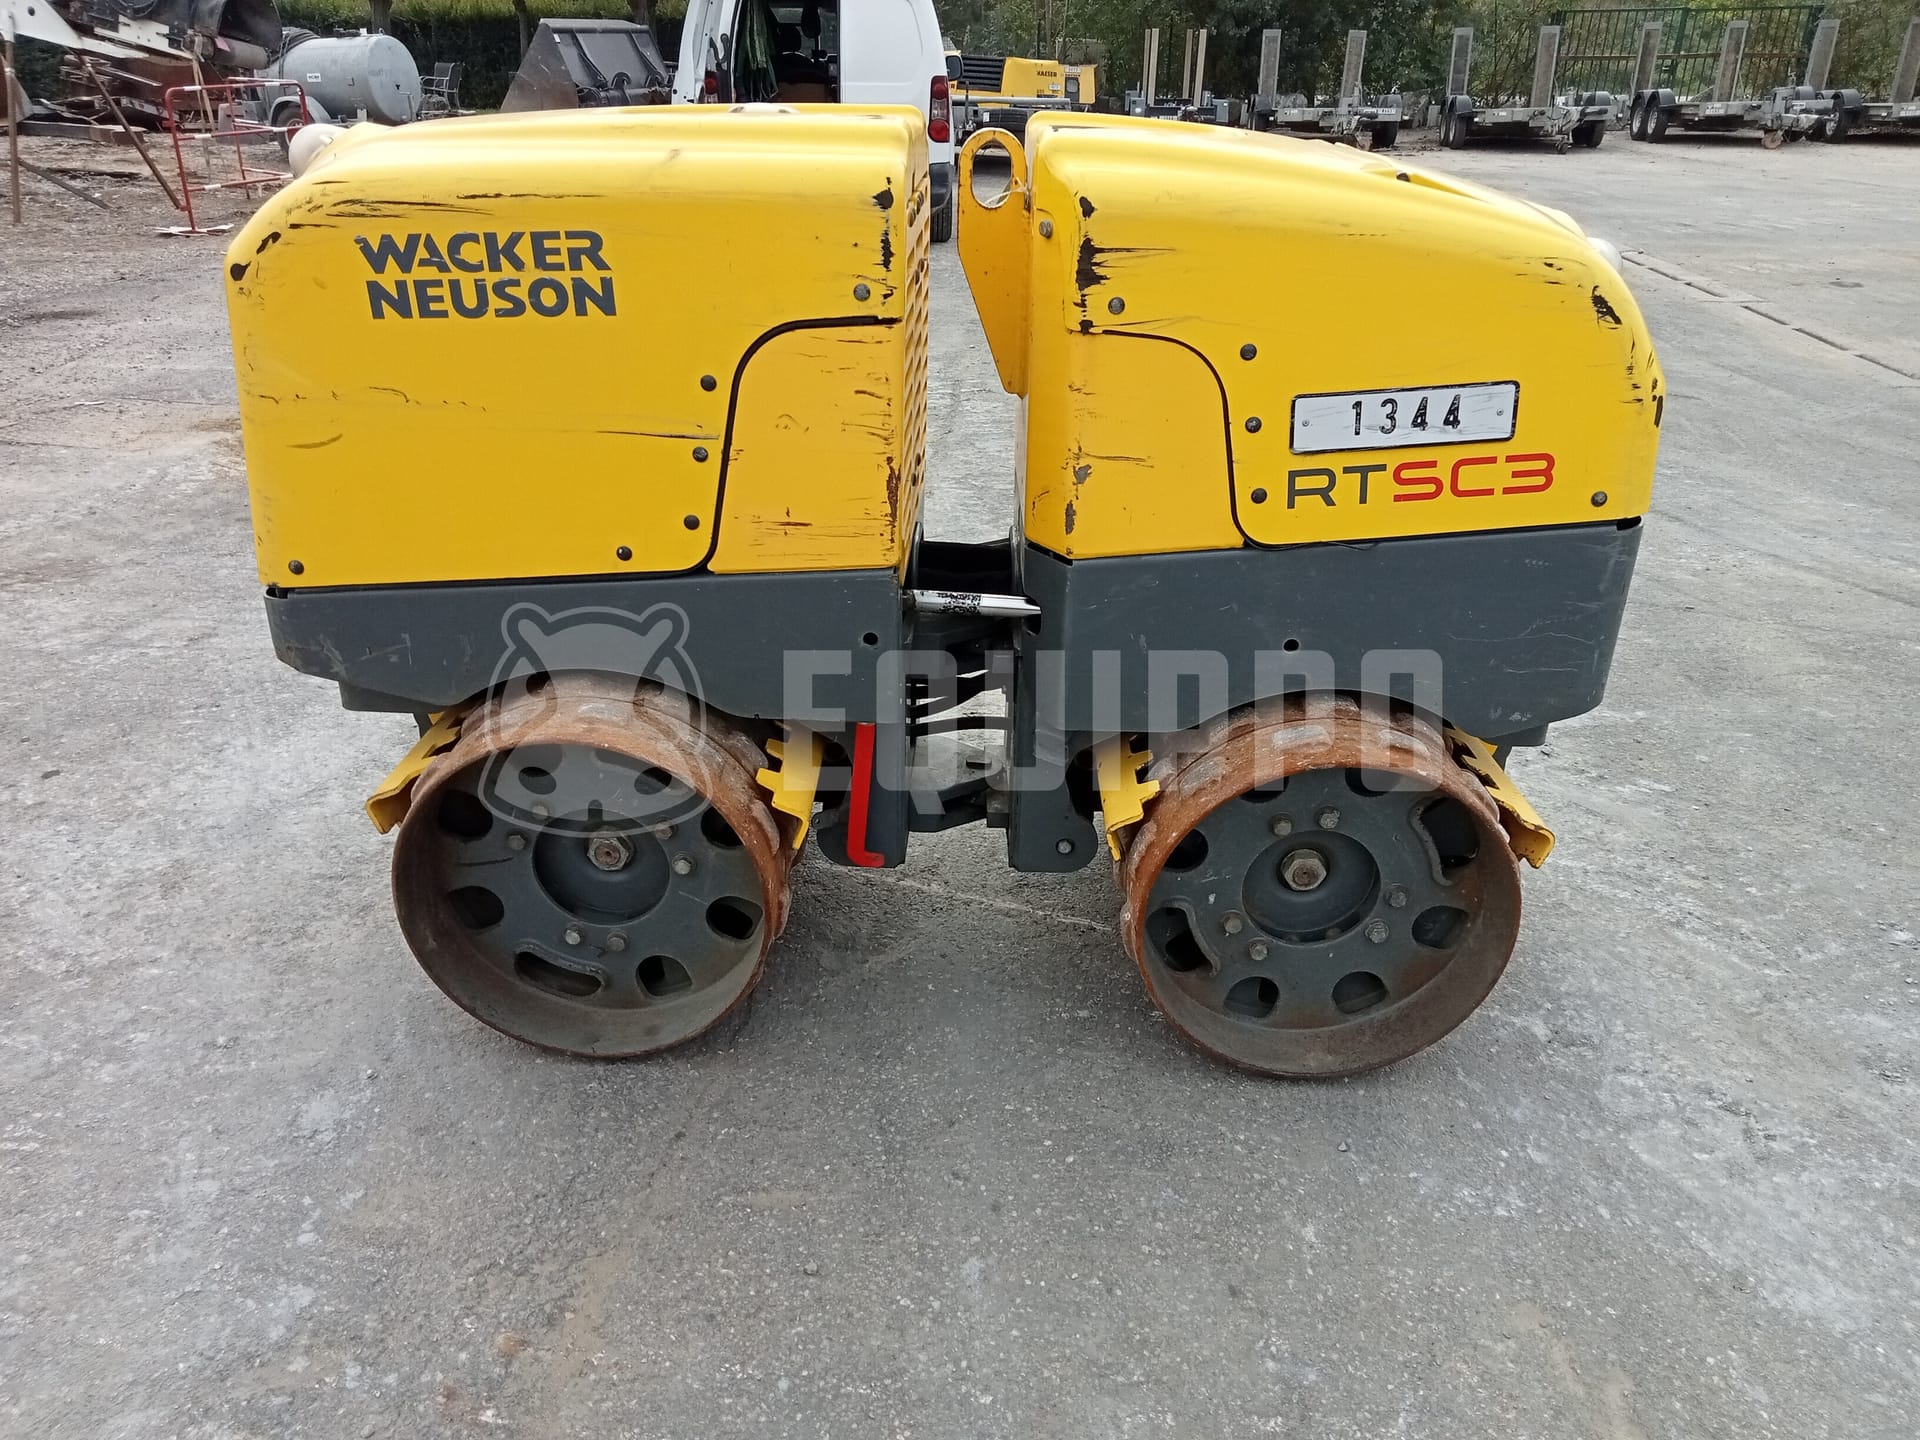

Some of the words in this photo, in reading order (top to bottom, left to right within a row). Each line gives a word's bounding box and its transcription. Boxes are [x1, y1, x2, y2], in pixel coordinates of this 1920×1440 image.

[354, 230, 612, 275] WACKER
[366, 276, 617, 320] NEUSON
[1351, 393, 1461, 436] 1344
[1287, 453, 1556, 510] RTSC3
